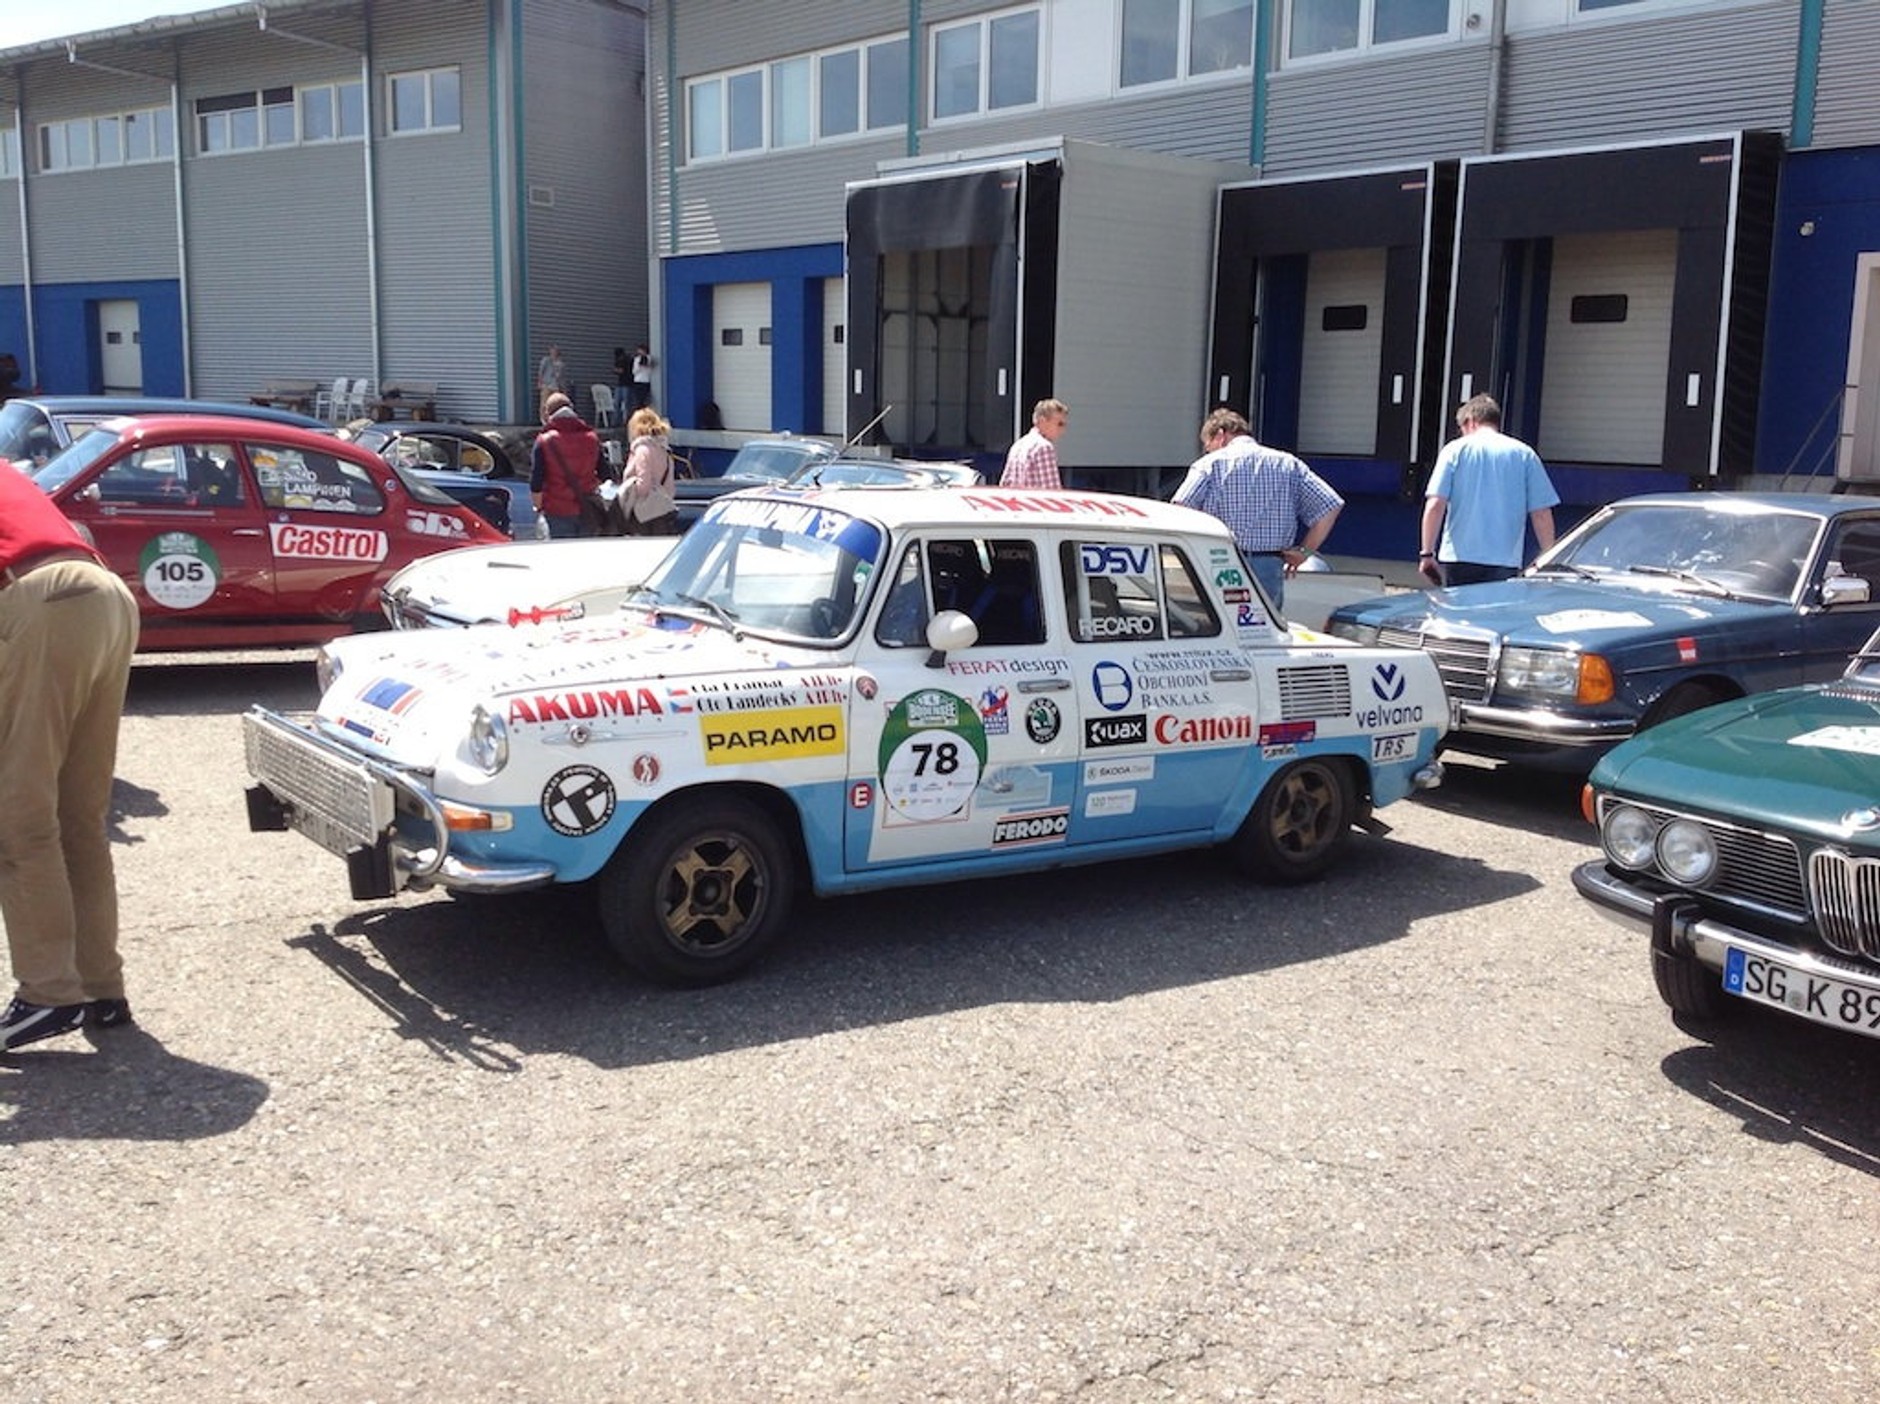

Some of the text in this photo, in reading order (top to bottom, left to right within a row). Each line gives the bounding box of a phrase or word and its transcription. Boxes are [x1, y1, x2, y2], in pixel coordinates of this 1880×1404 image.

[961, 494, 1149, 518] AKUMA
[277, 526, 379, 559] Castrol
[156, 562, 204, 582] 105
[1082, 545, 1149, 575] DSV
[1079, 615, 1154, 636] RECARO
[508, 687, 663, 725] AKUMA
[1357, 705, 1423, 728] velvana
[706, 723, 837, 751] PARAMO
[1155, 714, 1252, 745] Canon
[1374, 732, 1416, 758] TRS
[911, 743, 959, 776] 78
[854, 785, 866, 806] E
[995, 816, 1067, 842] FERODO
[1730, 973, 1739, 985] D
[1745, 960, 1786, 1003] SG
[1806, 978, 1831, 1017] K
